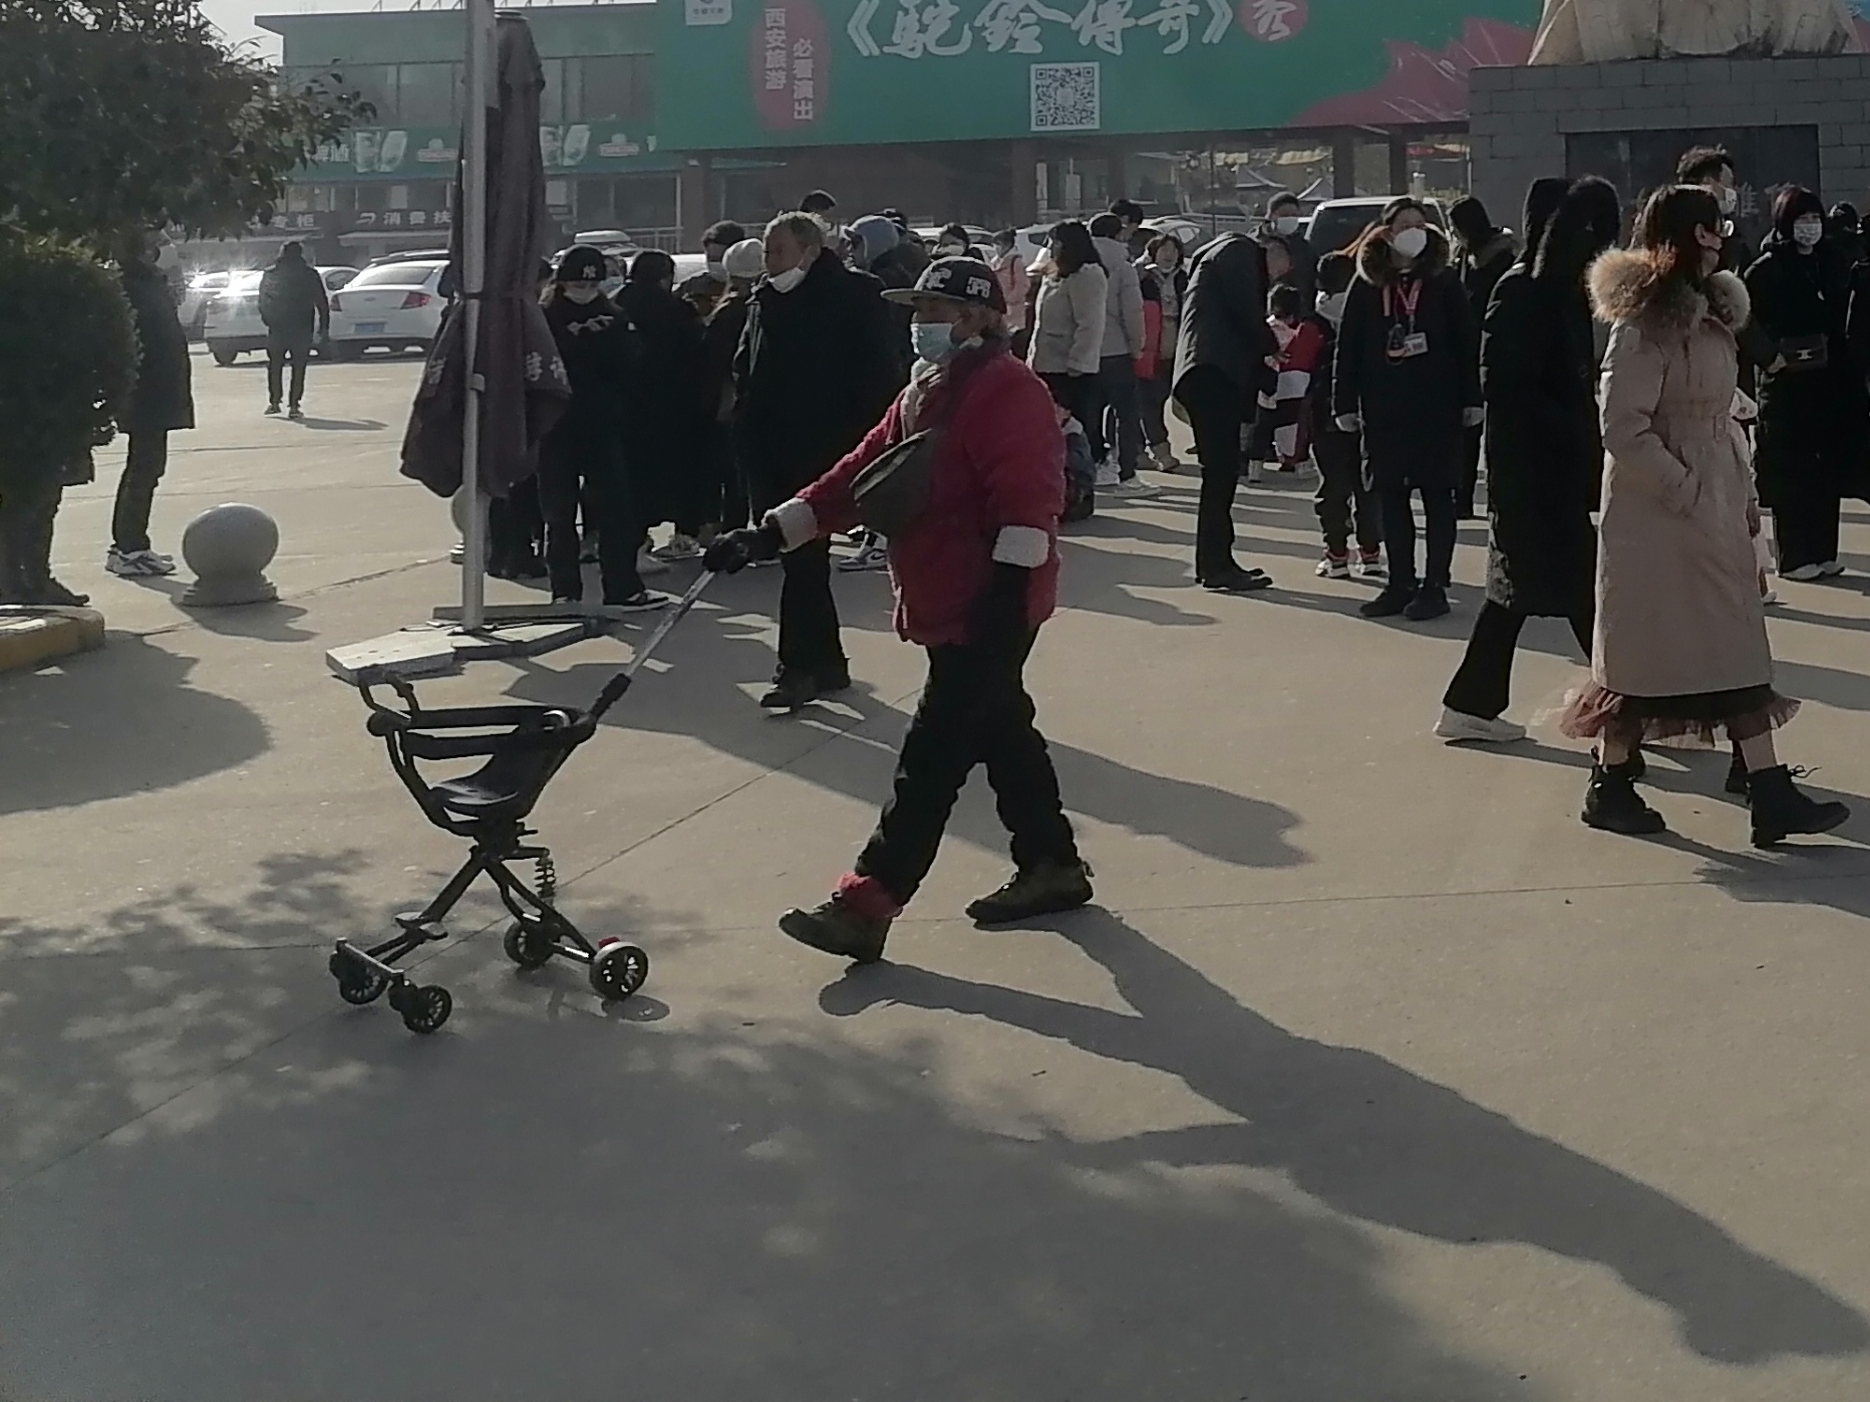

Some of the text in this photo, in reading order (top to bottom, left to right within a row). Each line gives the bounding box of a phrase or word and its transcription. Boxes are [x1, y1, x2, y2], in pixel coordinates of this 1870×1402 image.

[765, 8, 786, 90] 西安旅游
[793, 38, 815, 120] 必看演出
